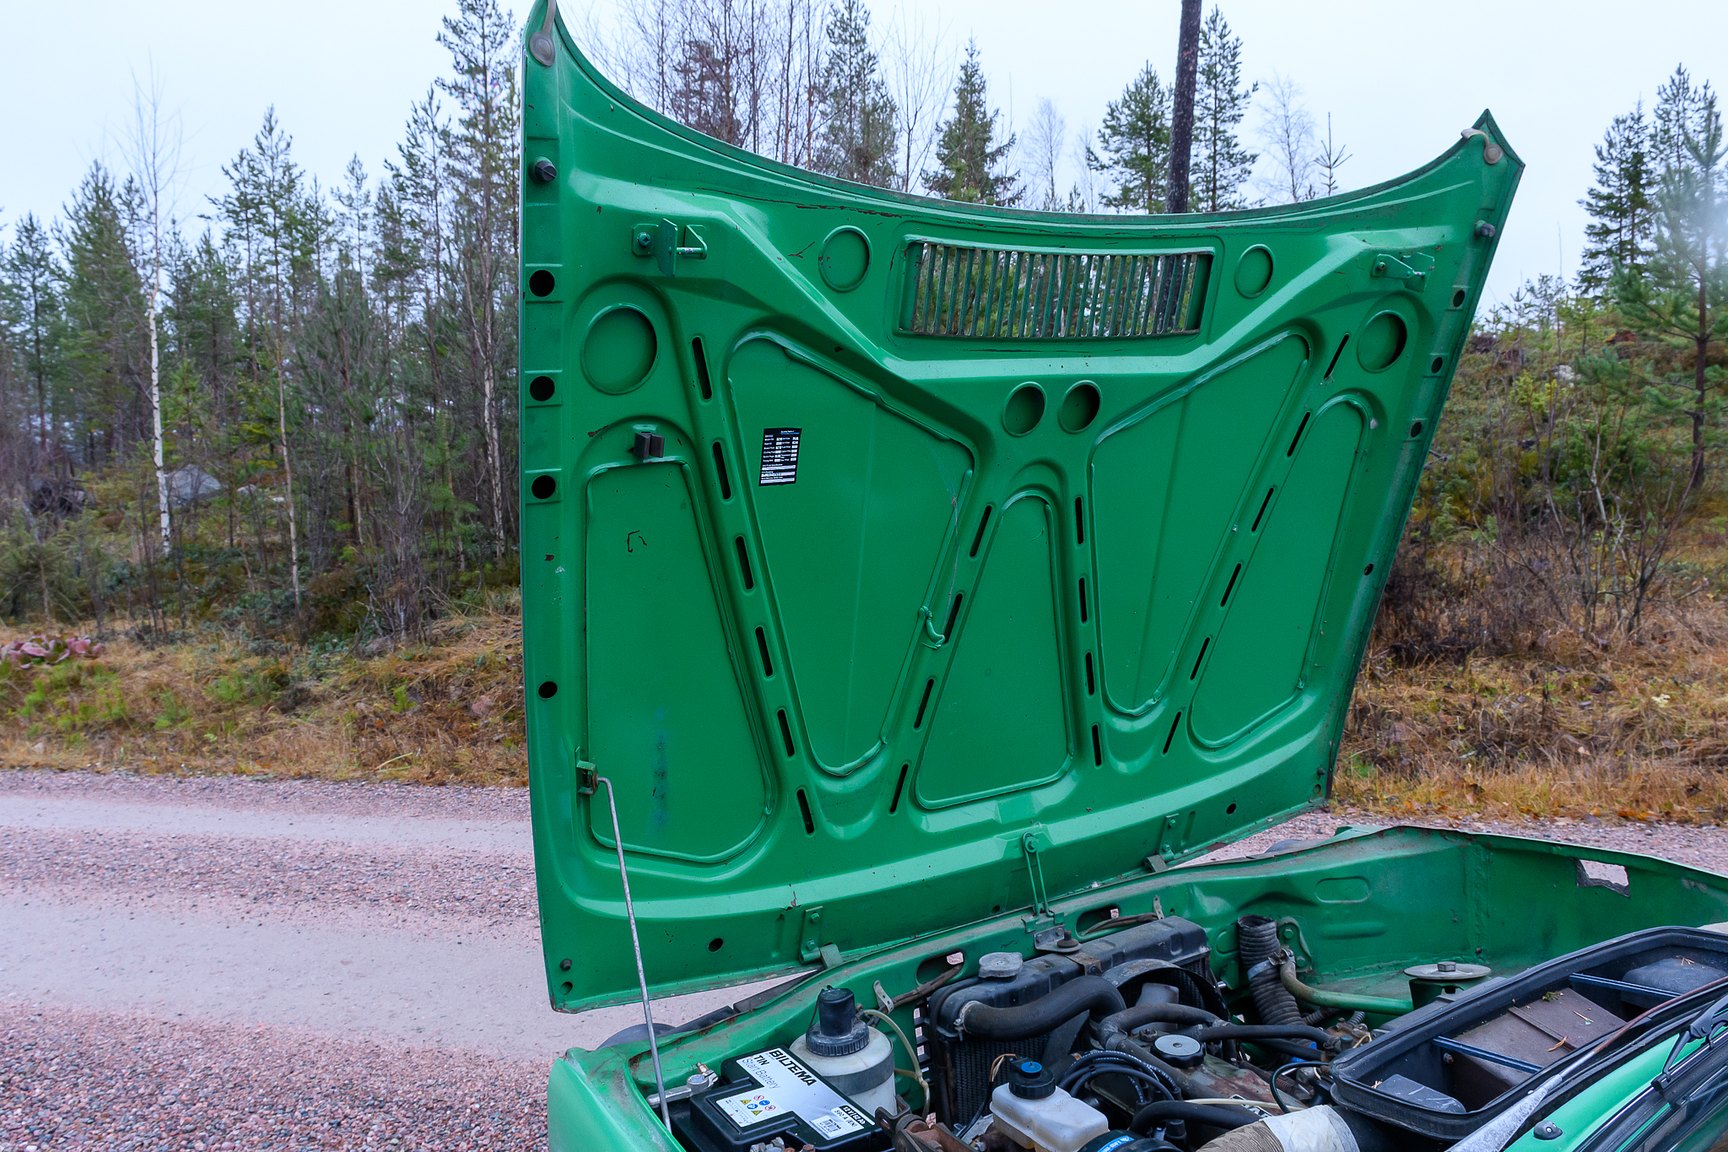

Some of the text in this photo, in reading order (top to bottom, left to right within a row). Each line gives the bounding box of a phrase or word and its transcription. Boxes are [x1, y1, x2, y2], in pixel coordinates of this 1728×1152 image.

[742, 1058, 781, 1089] Start Battery
[769, 1050, 817, 1086] BILTEMA
